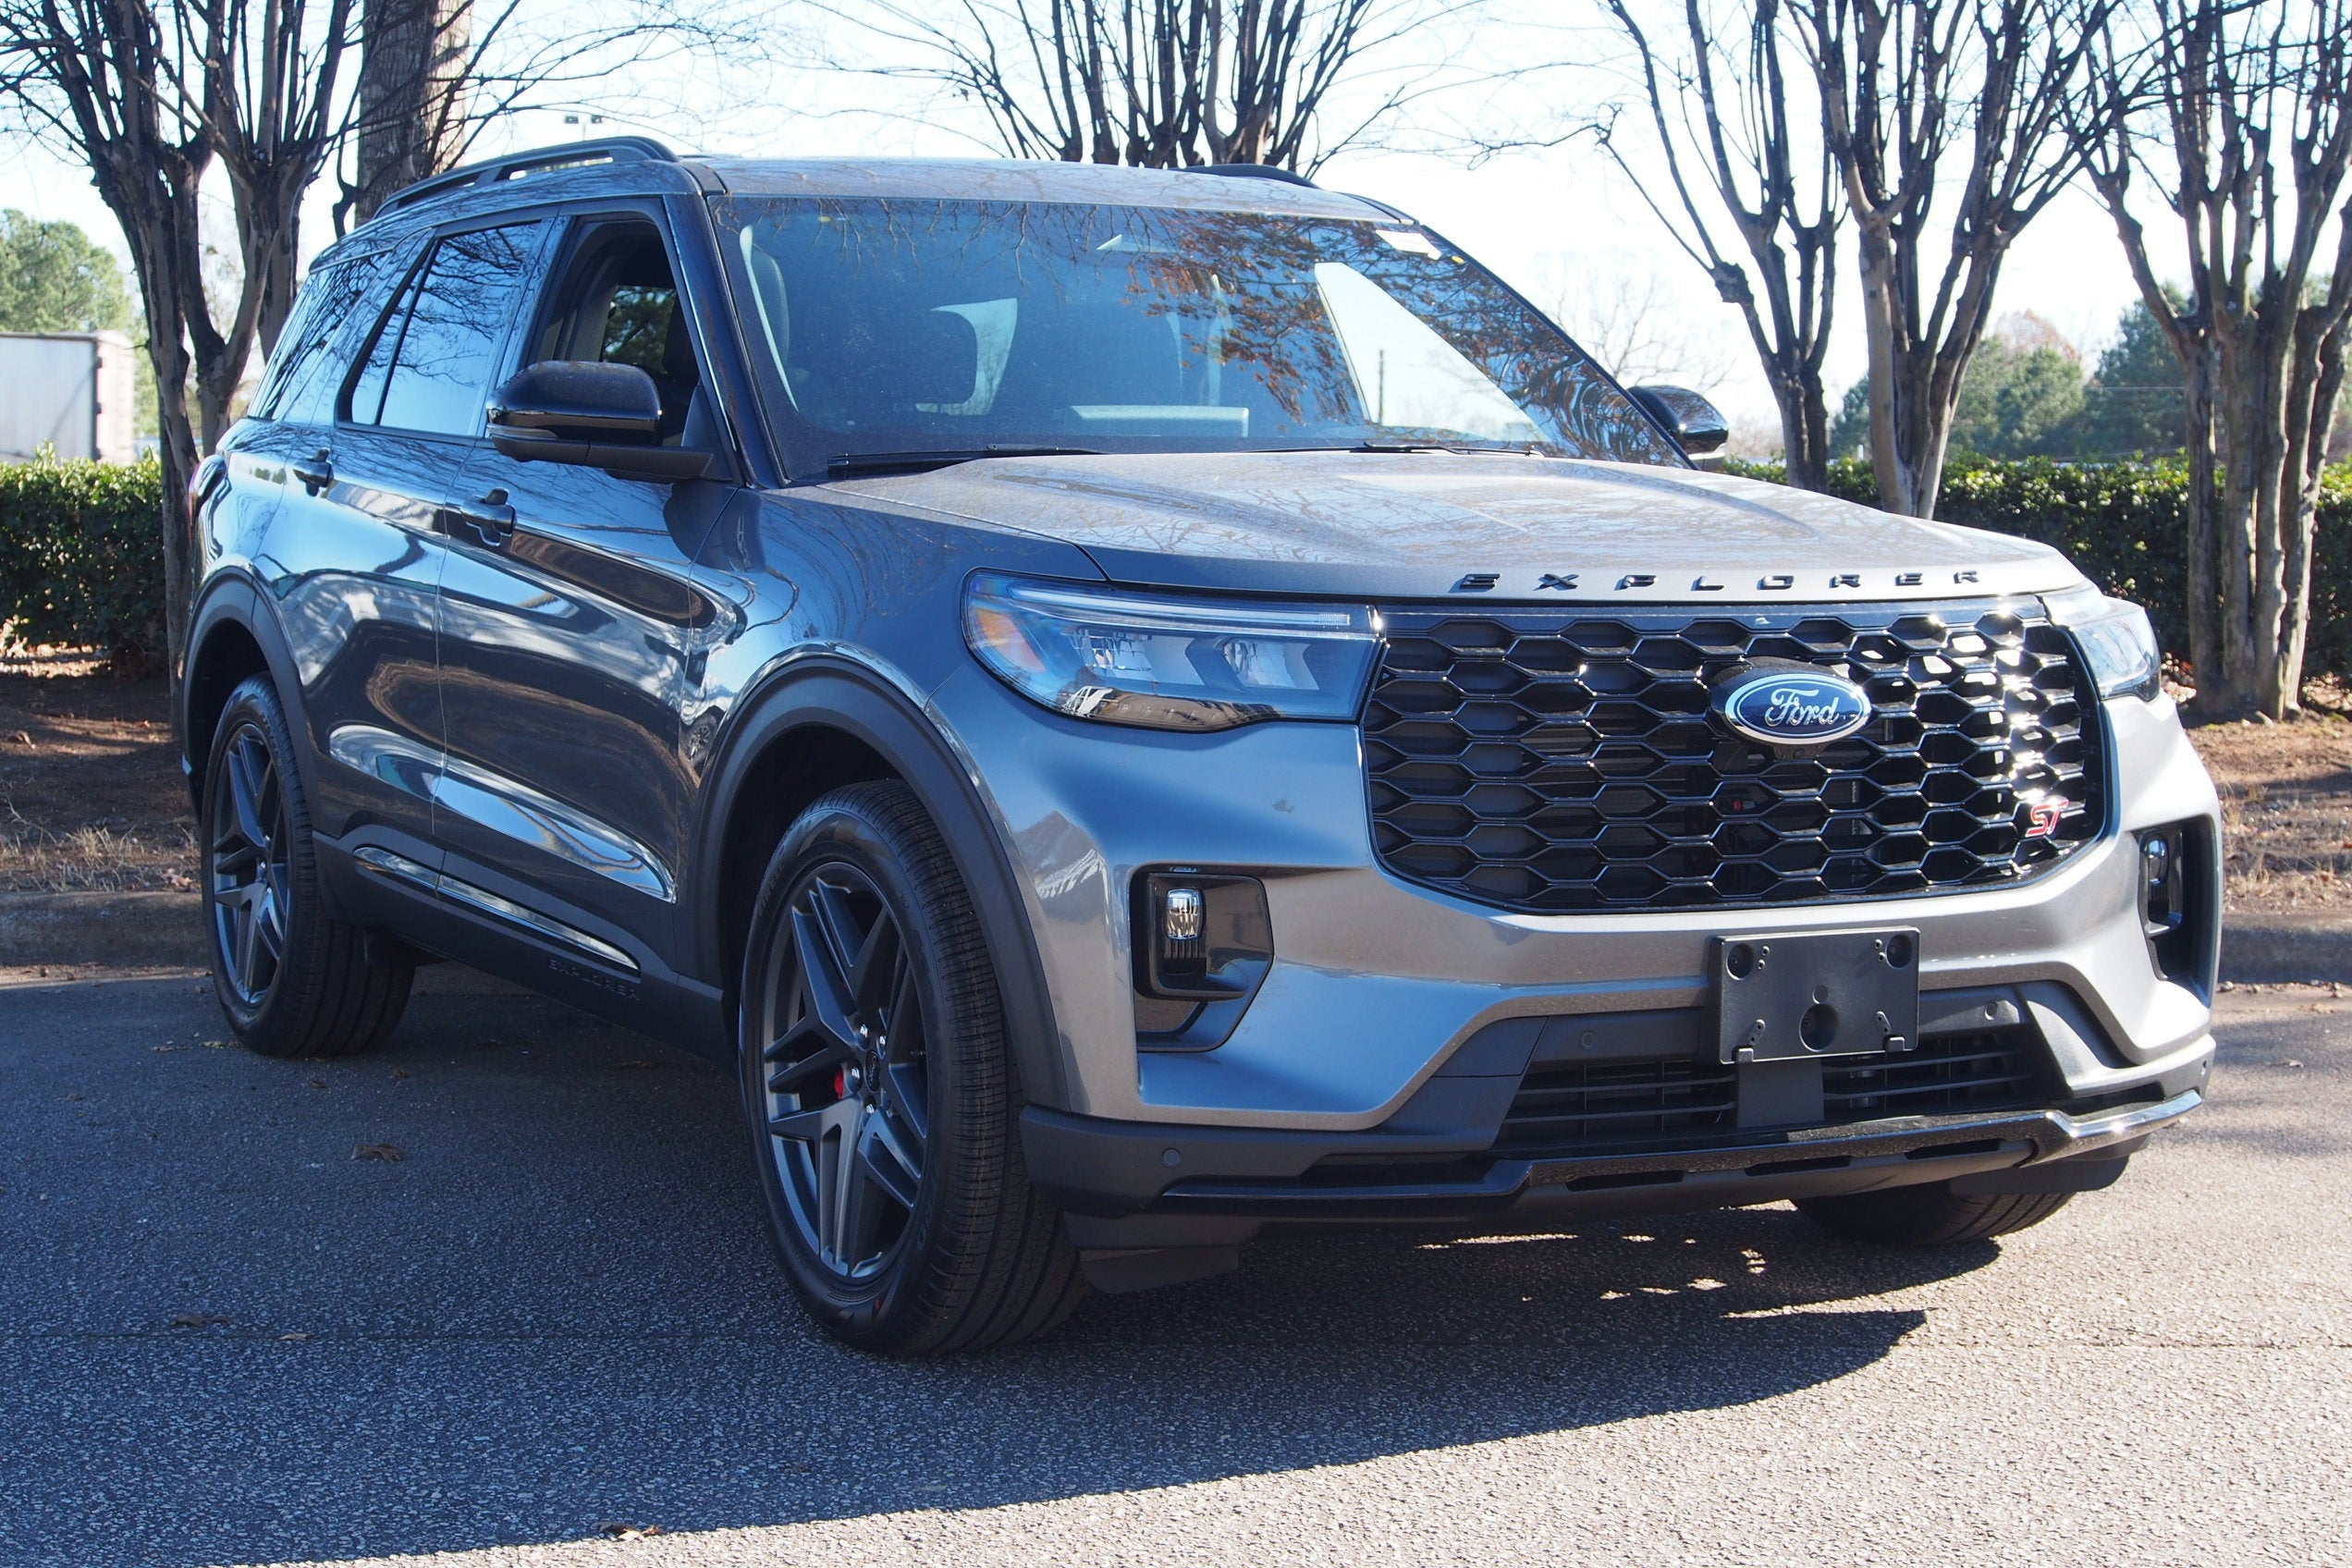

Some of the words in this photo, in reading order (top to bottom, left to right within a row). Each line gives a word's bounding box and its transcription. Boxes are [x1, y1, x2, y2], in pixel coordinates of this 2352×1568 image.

[1457, 570, 1980, 593] EXPLORER
[1764, 688, 1840, 727] Ford
[2025, 799, 2068, 838] ST
